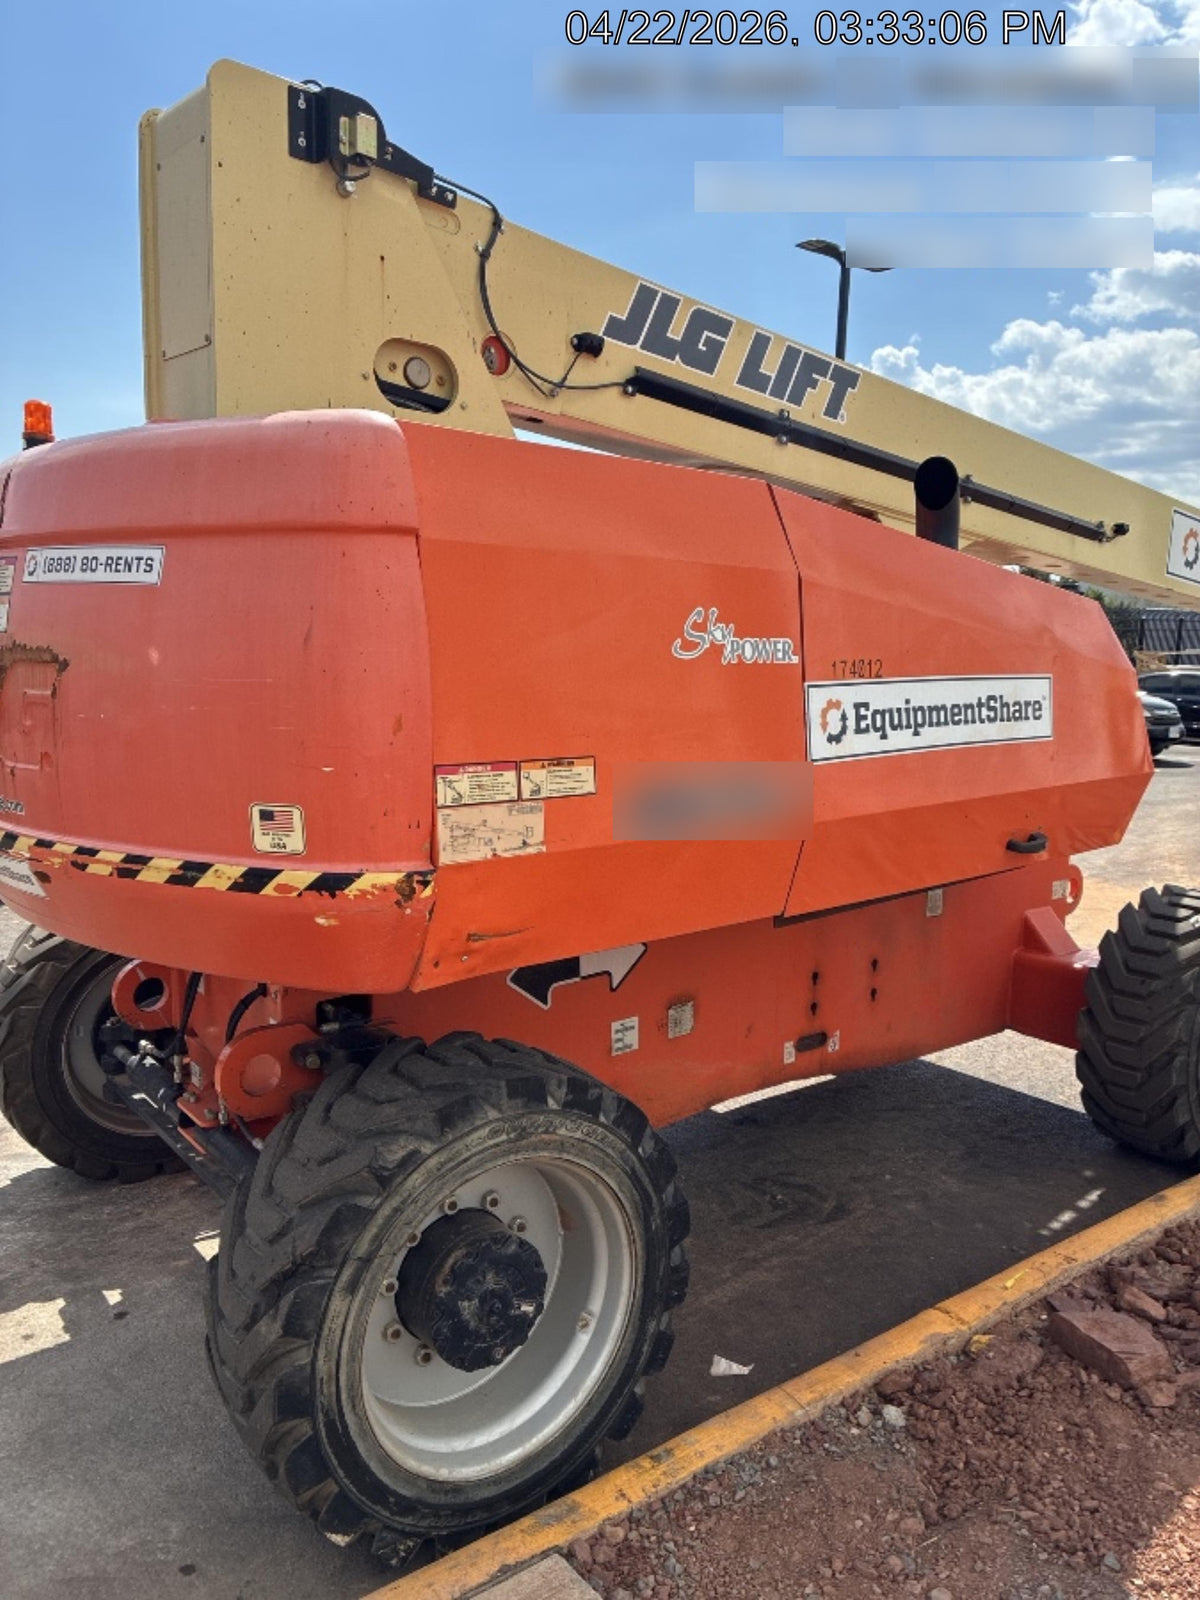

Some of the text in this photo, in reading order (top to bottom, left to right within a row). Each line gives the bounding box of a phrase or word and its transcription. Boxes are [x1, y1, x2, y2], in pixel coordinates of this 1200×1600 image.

[600, 279, 863, 424] JLG LIFT
[42, 555, 155, 575] (888) 80-RENTS
[672, 606, 795, 665] Sky POWER
[852, 694, 1043, 740] EquipmentShare
